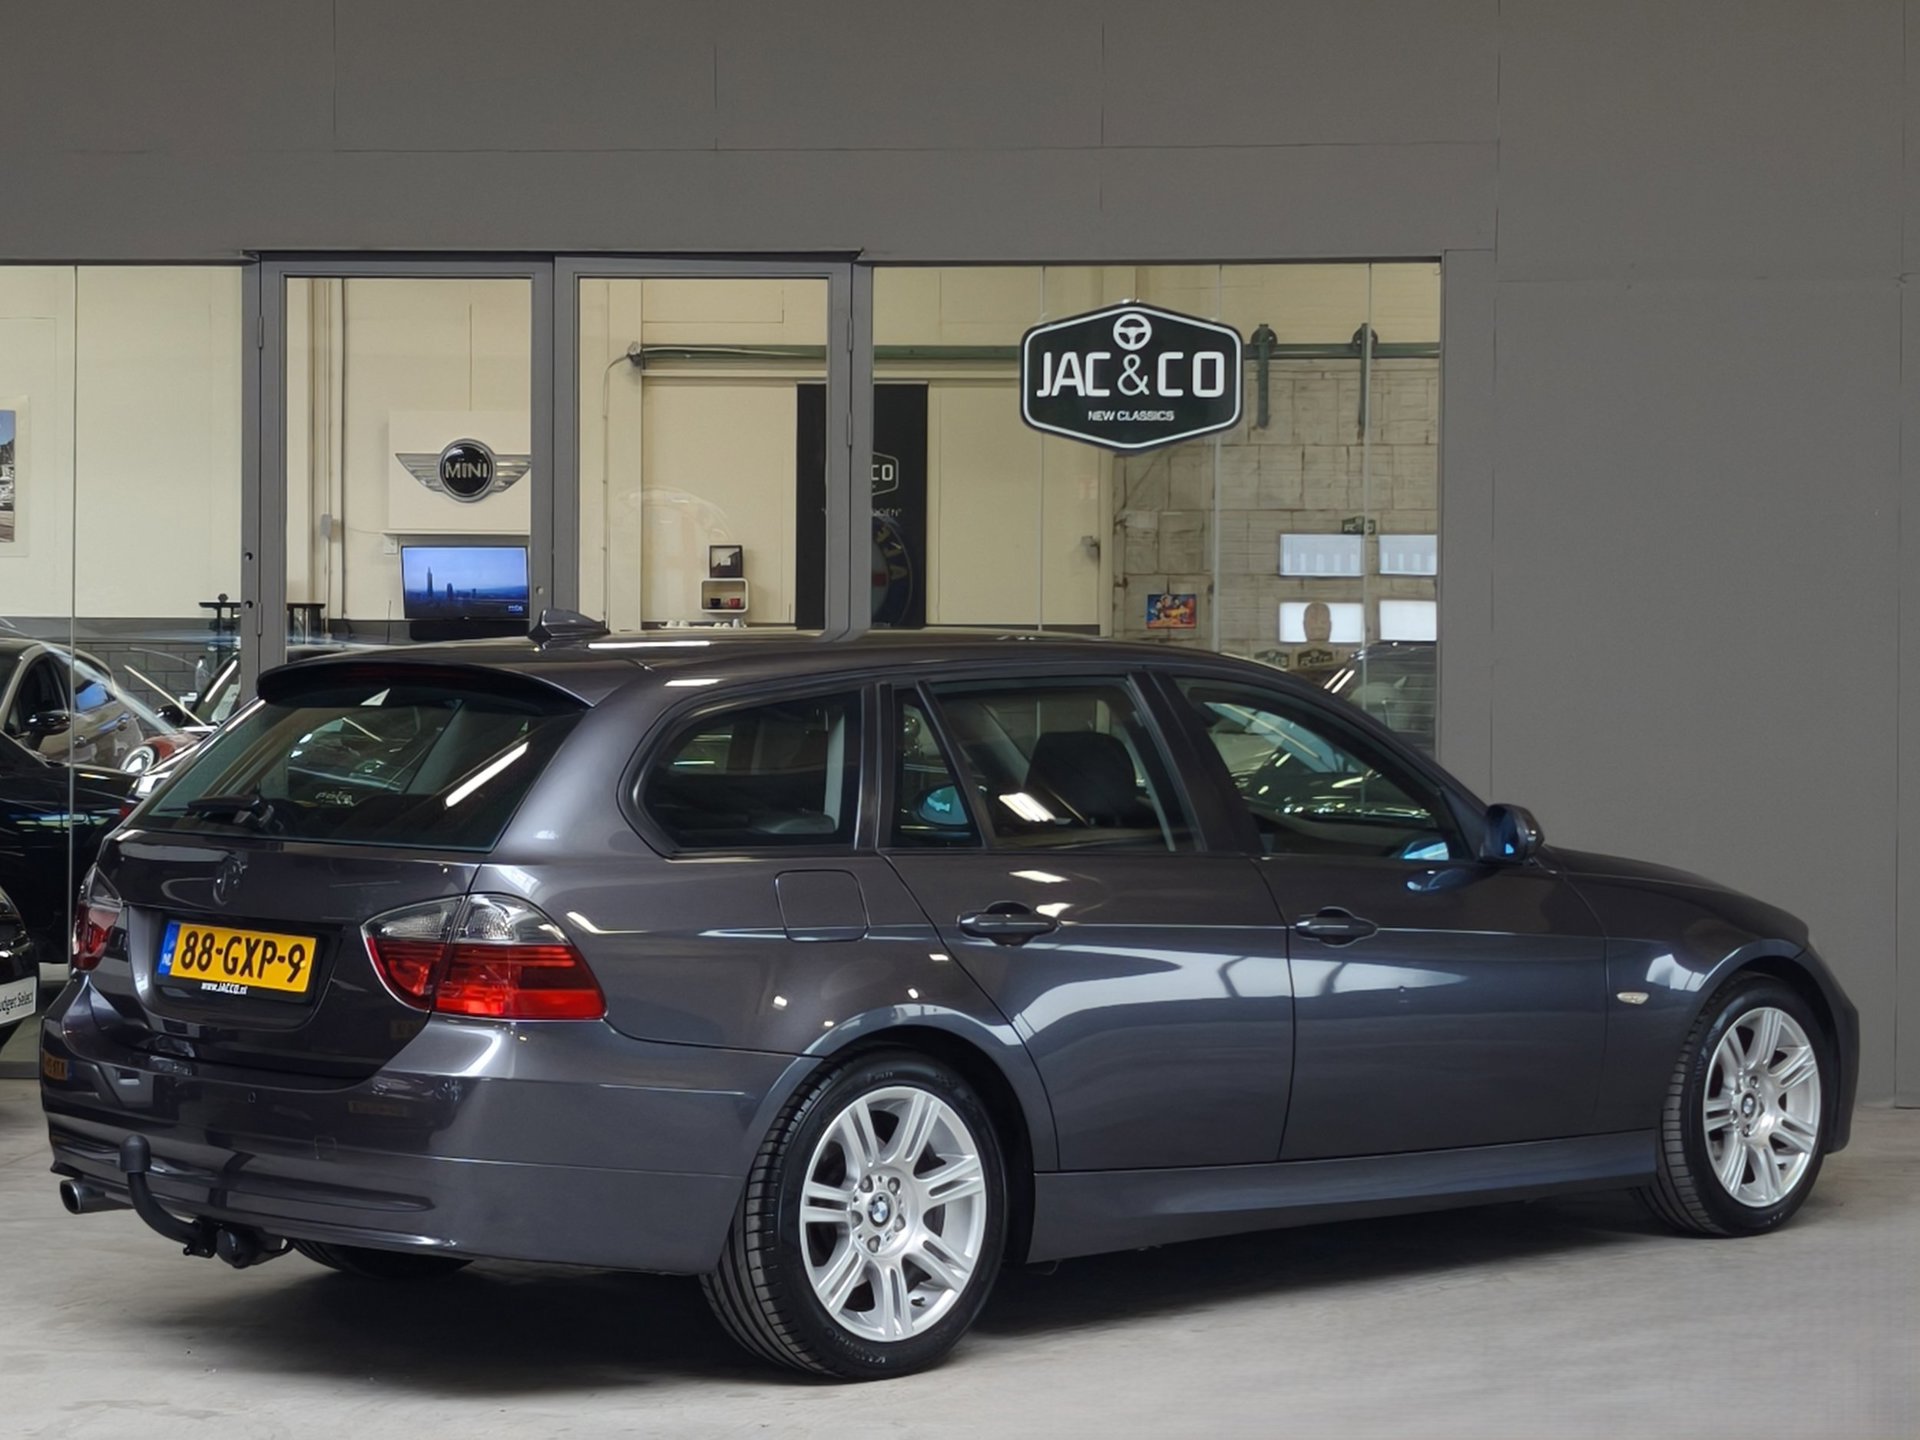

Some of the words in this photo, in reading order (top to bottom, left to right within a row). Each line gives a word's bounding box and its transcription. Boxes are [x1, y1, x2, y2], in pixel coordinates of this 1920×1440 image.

[1087, 410, 1115, 421] NEW
[1116, 410, 1175, 422] CLASSICS
[445, 461, 488, 479] MINI
[180, 930, 306, 984] 88-GXP-9
